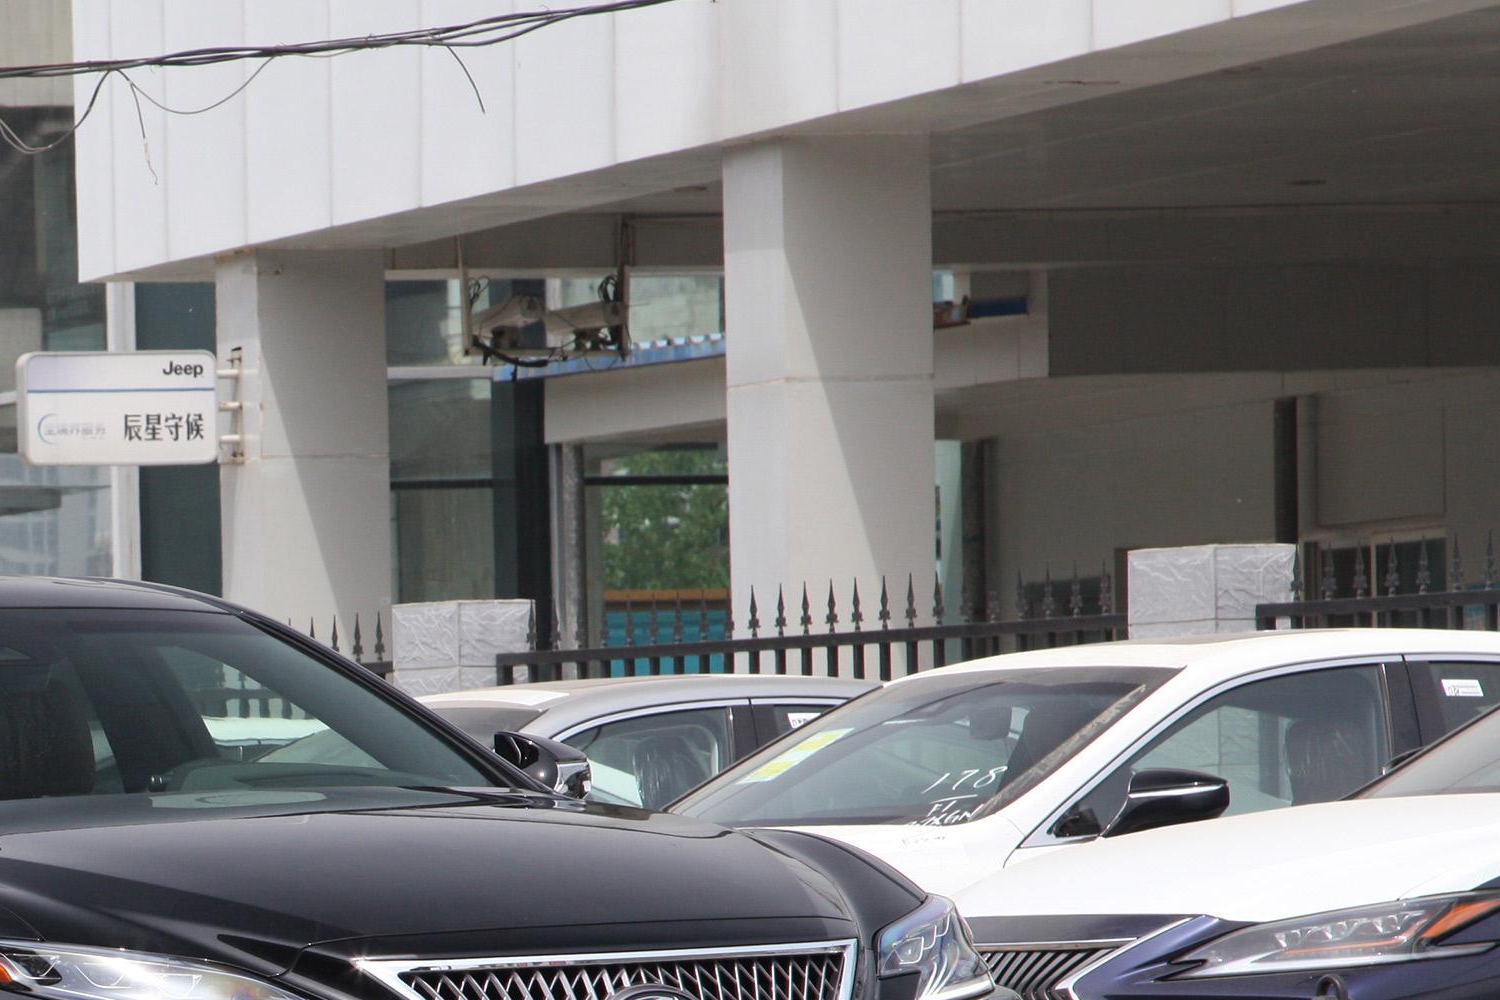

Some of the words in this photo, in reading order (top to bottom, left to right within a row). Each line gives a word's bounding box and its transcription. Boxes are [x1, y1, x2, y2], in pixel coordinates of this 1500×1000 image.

[162, 361, 204, 378] Jeep
[124, 413, 205, 441] 辰星守候
[921, 766, 1008, 794] 178
